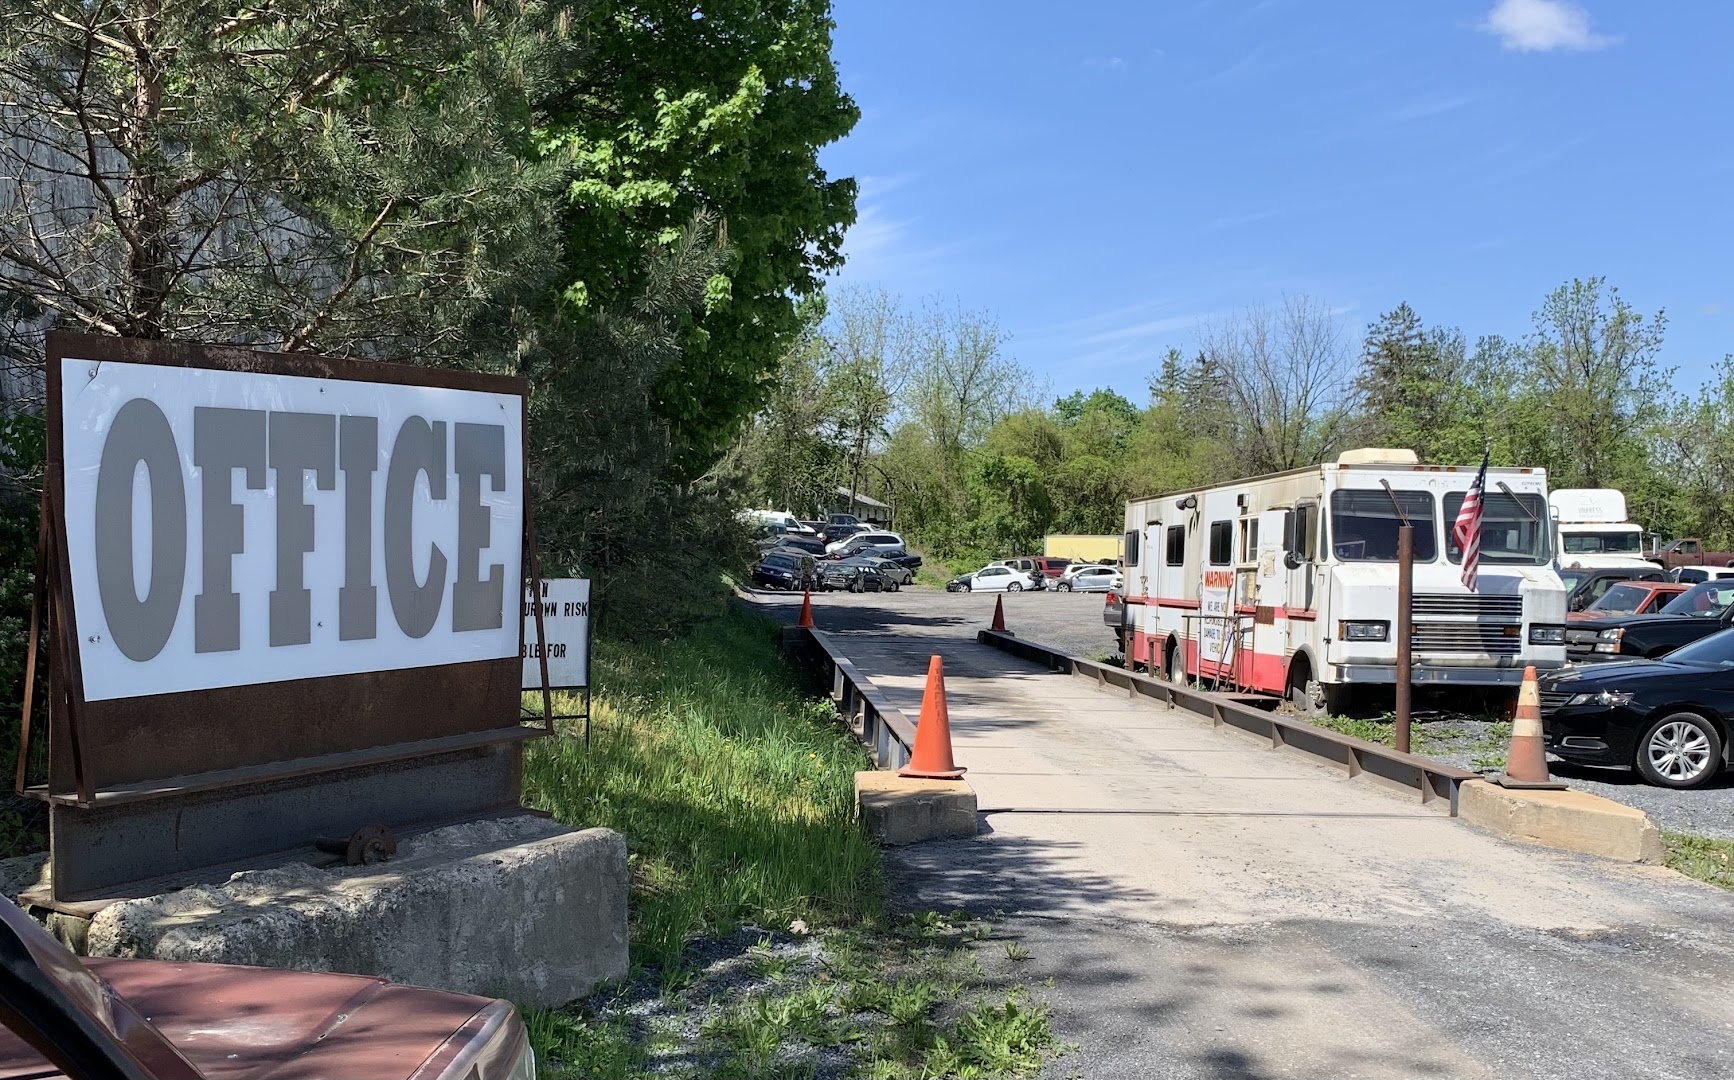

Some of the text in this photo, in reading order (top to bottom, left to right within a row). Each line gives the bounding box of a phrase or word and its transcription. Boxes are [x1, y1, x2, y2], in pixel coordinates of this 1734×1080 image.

[95, 397, 506, 663] OFFICE
[1205, 571, 1234, 588] WARNING
[540, 602, 557, 617] WN
[564, 602, 588, 617] RISK
[547, 643, 567, 658] FOR
